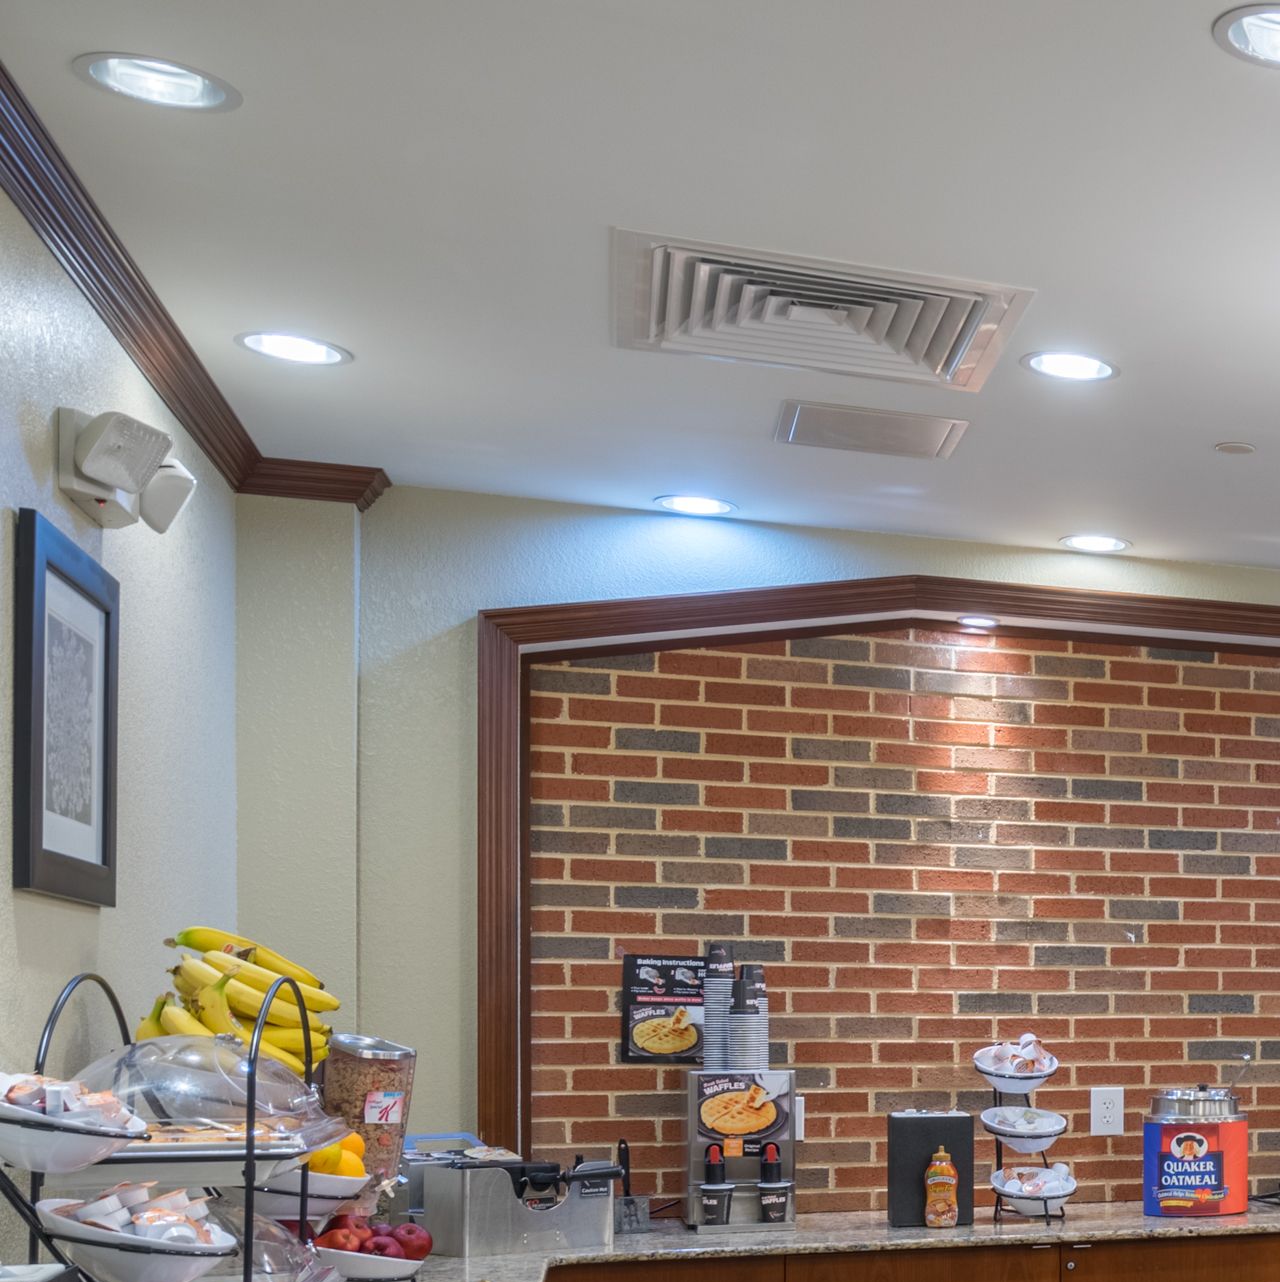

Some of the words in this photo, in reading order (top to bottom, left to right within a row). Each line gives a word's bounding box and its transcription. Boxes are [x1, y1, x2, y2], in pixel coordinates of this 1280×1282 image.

[636, 958, 662, 966] Baking
[662, 959, 705, 967] Instructions
[633, 1009, 666, 1020] WAFFLES
[703, 1082, 746, 1095] WAFFLES
[378, 1101, 397, 1122] K
[1163, 1160, 1215, 1174] QUAKER
[1161, 1174, 1218, 1186] OATMEAL
